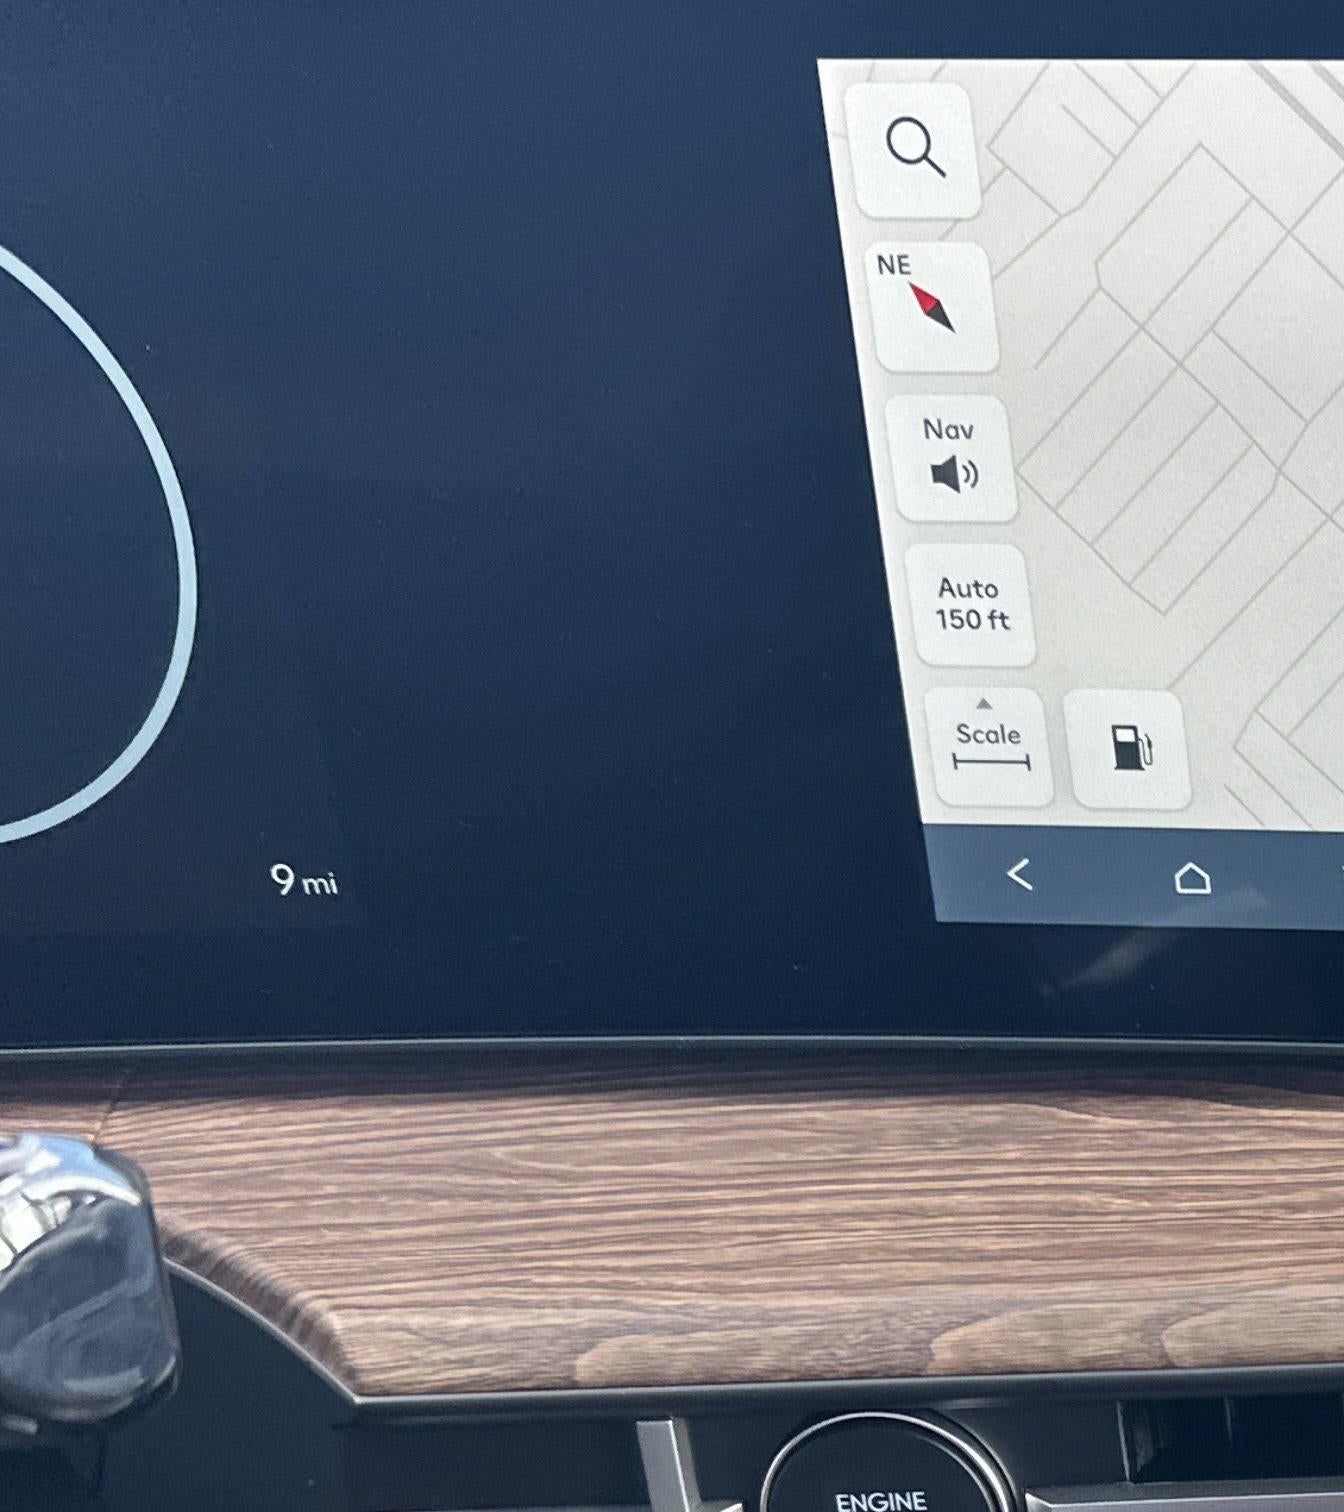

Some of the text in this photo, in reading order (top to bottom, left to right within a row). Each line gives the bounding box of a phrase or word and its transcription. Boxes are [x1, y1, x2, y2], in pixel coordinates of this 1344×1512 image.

[877, 254, 912, 276] NE
[923, 418, 974, 440] Nav
[938, 576, 999, 599] Auto
[935, 608, 1011, 631] 150 ft
[956, 722, 1022, 745] Scale
[270, 863, 338, 896] 9 mi
